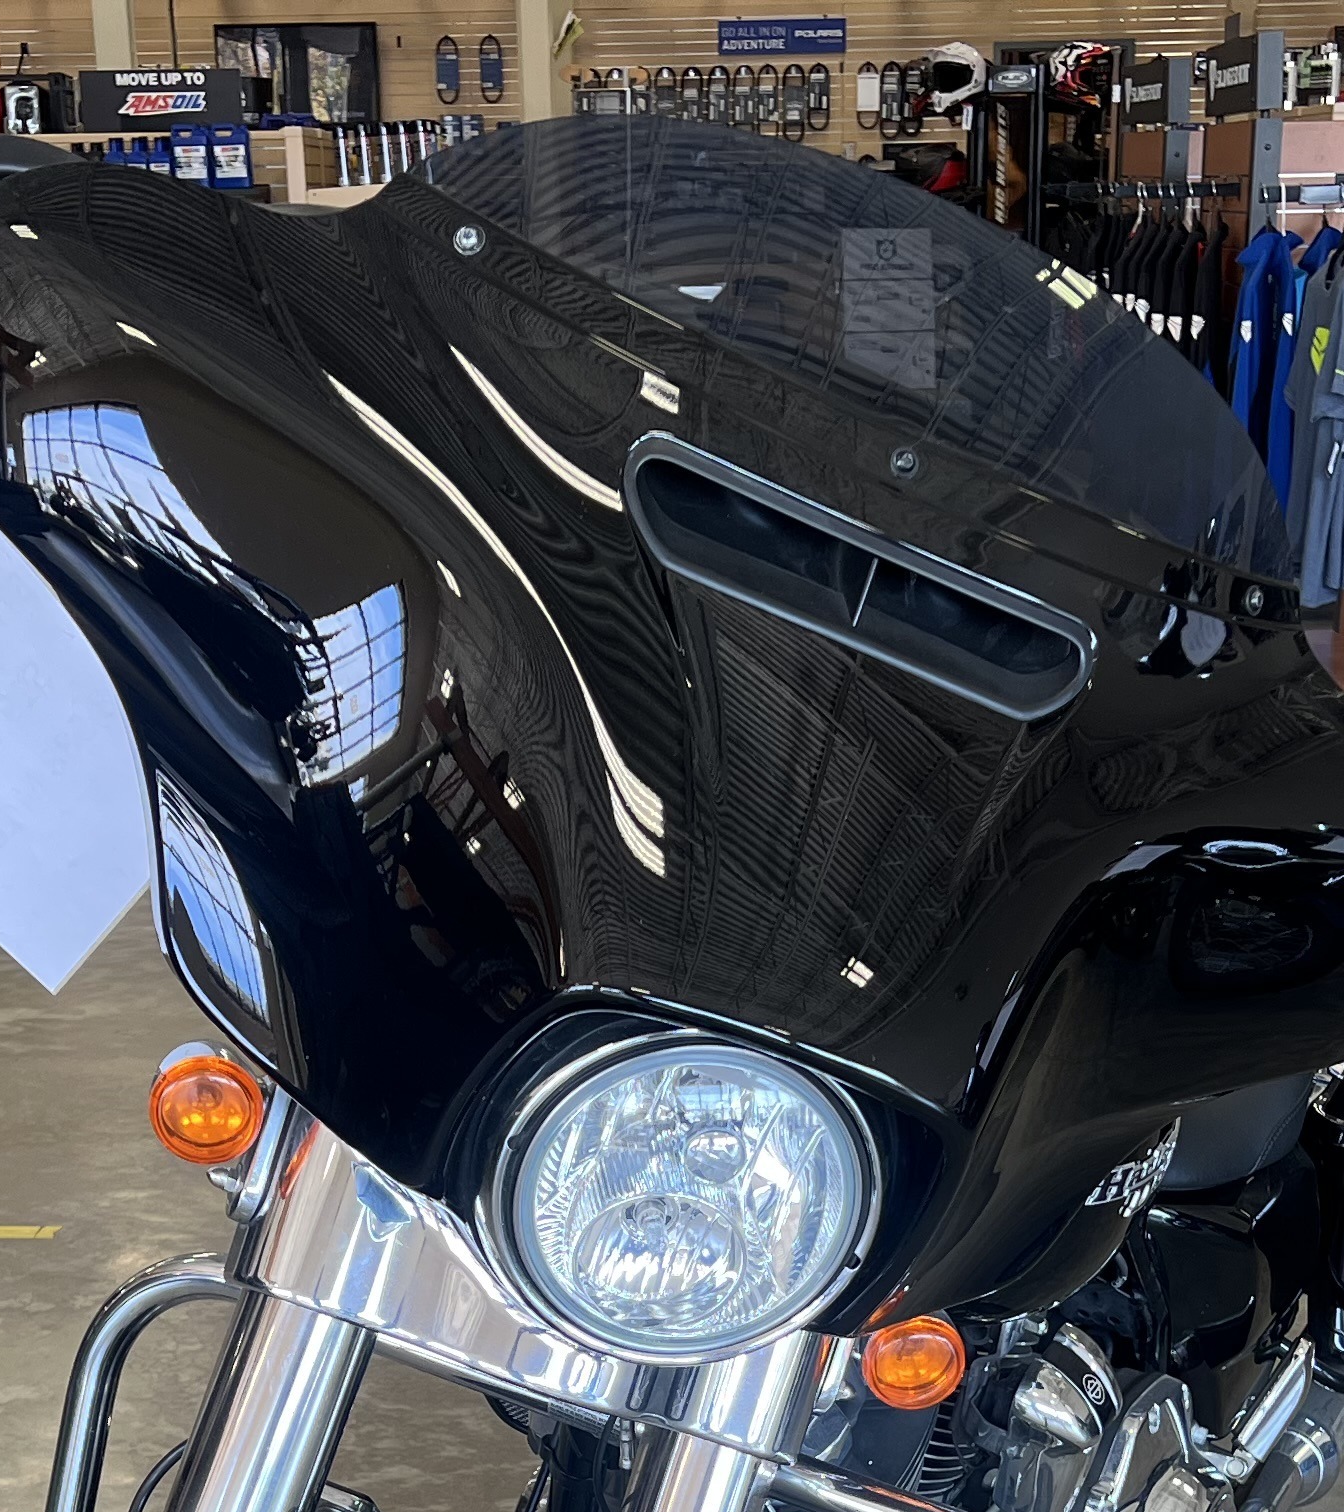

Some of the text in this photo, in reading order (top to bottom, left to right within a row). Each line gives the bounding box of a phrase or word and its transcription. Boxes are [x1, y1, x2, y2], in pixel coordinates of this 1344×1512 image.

[737, 26, 757, 37] ALL
[722, 39, 785, 50] ADVENTURE
[115, 72, 205, 86] MOVE UP TO
[119, 92, 206, 115] AMSOIL
